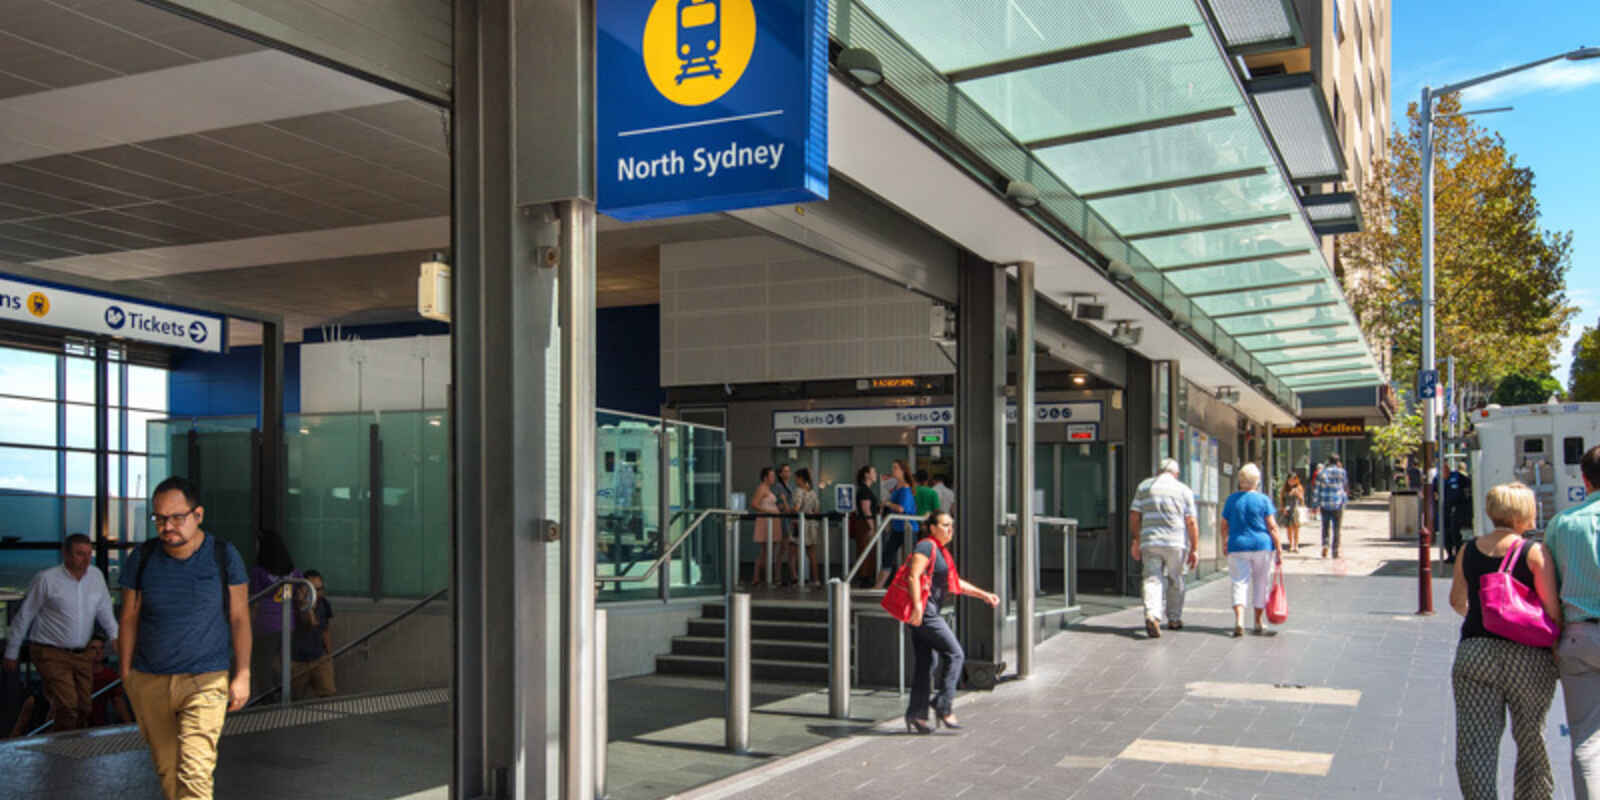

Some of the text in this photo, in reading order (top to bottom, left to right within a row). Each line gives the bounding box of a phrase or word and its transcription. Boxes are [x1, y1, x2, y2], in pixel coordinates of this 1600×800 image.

[617, 142, 785, 181] North Sydney
[128, 311, 185, 337] Tickets
[793, 415, 824, 426] Tickets
[896, 412, 928, 423] Tickets
